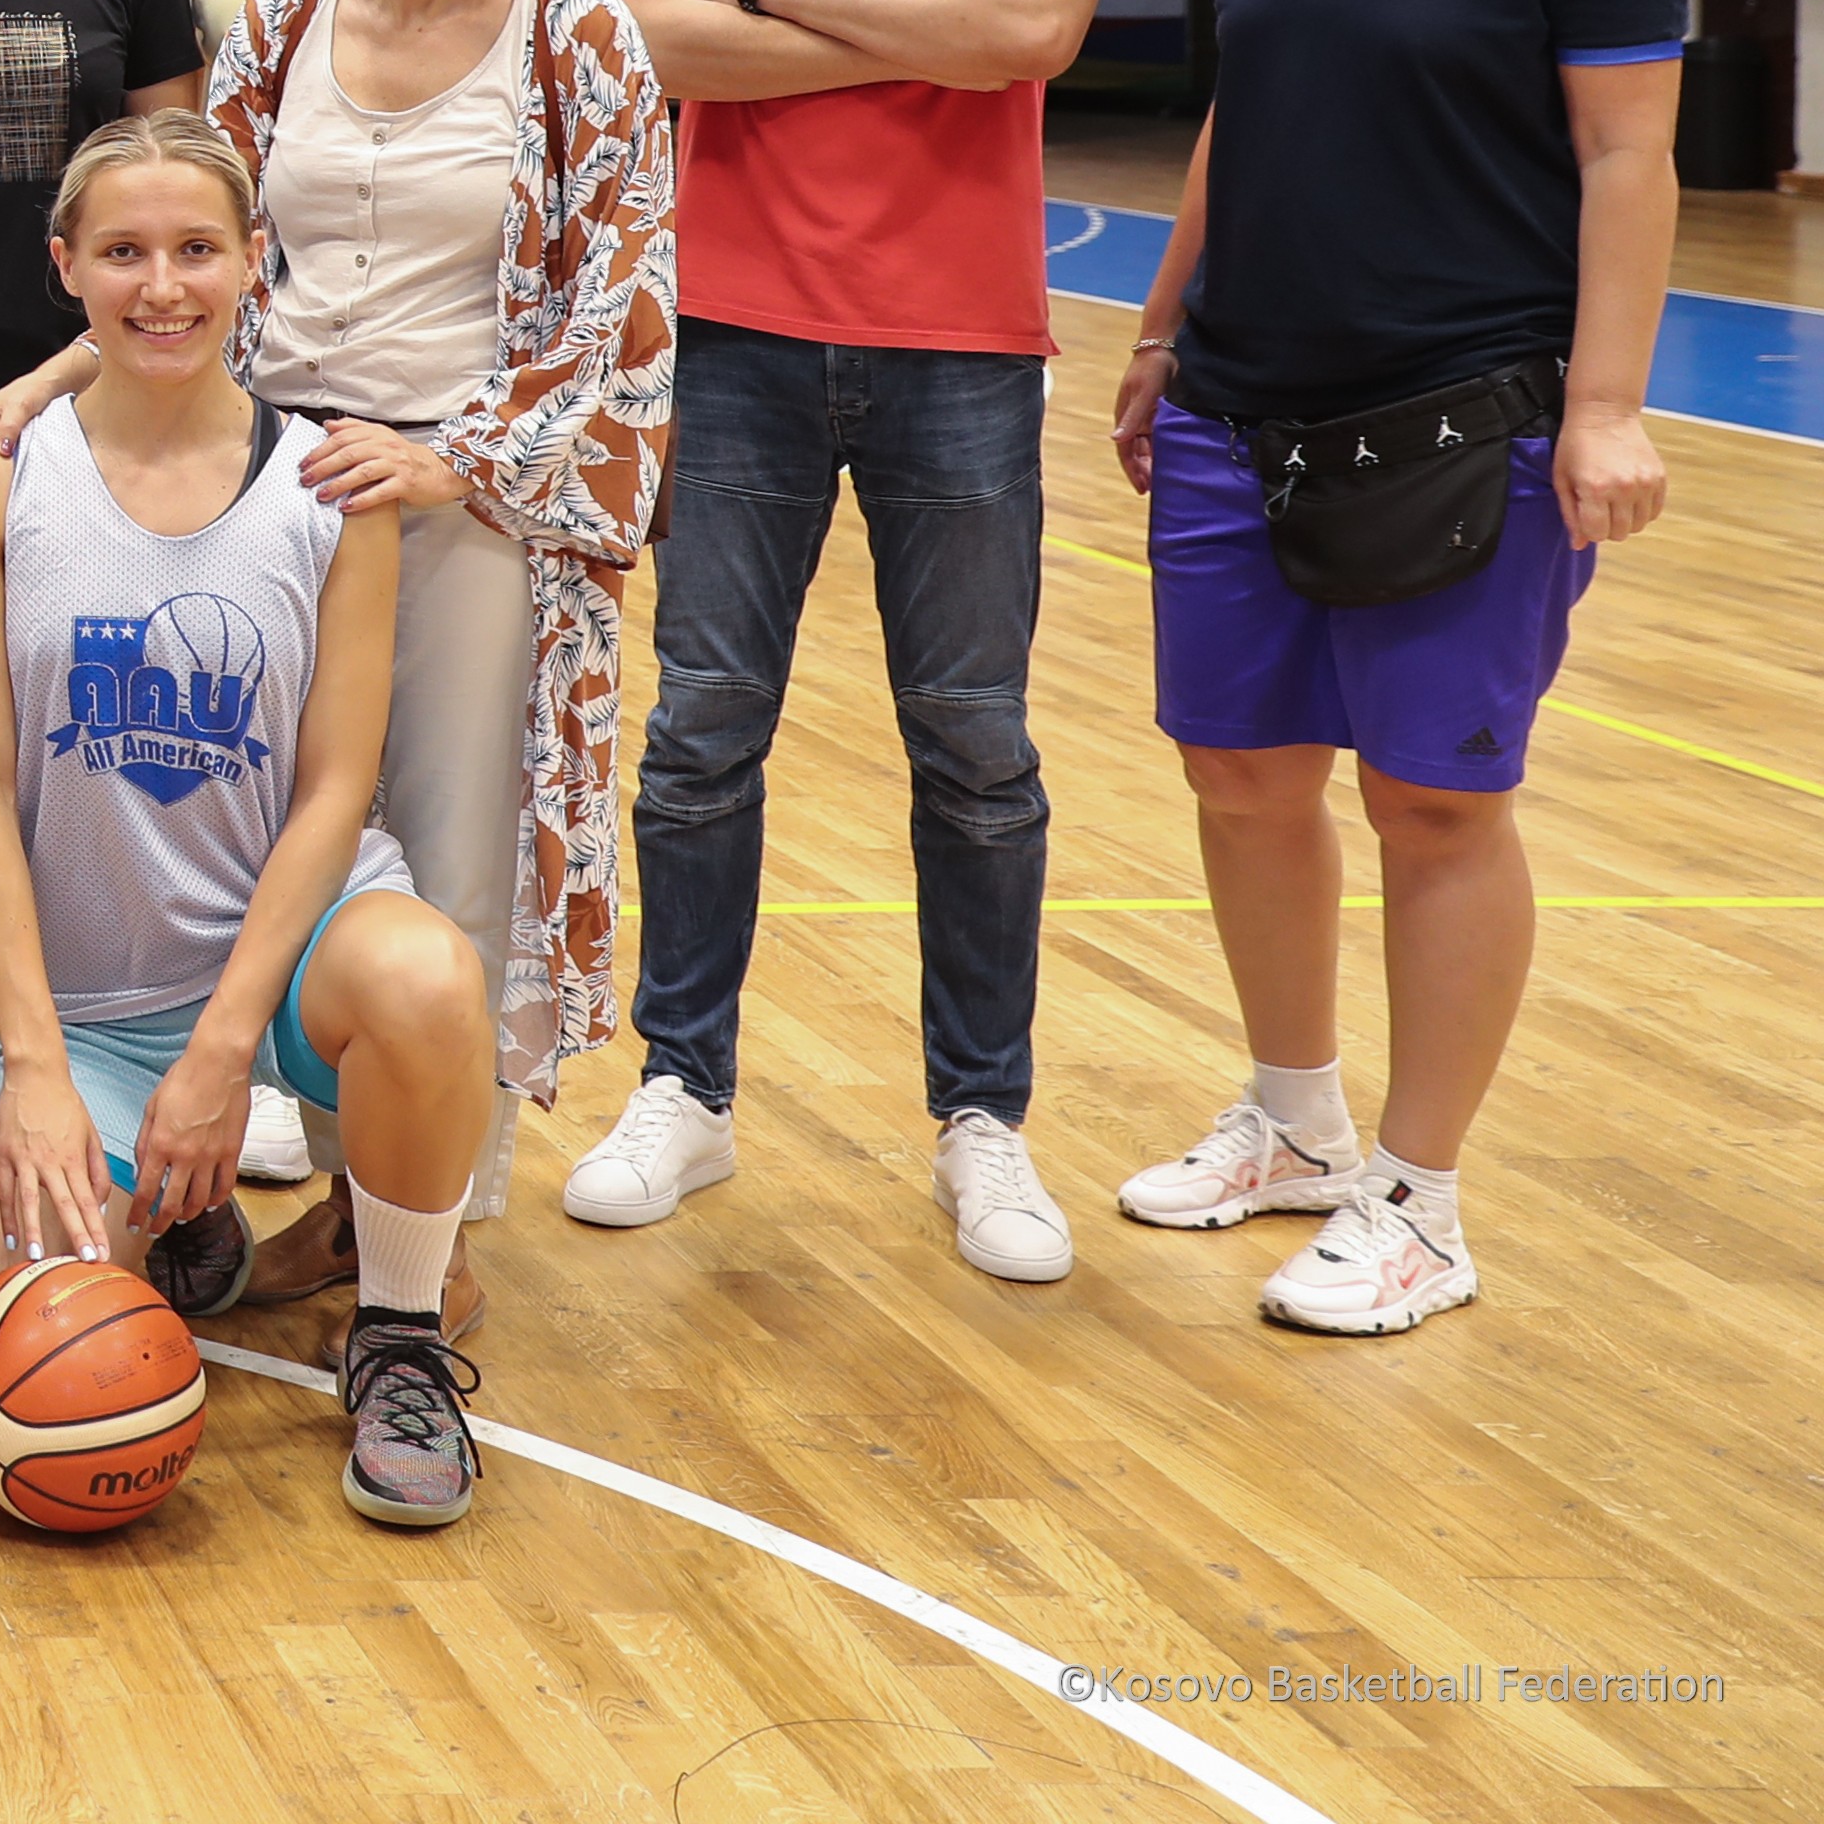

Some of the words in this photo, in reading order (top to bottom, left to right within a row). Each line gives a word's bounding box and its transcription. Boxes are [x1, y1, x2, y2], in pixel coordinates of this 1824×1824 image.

[67, 660, 246, 735] AAU
[82, 739, 118, 774] All
[120, 736, 244, 785] American
[87, 1444, 196, 1496] molte
